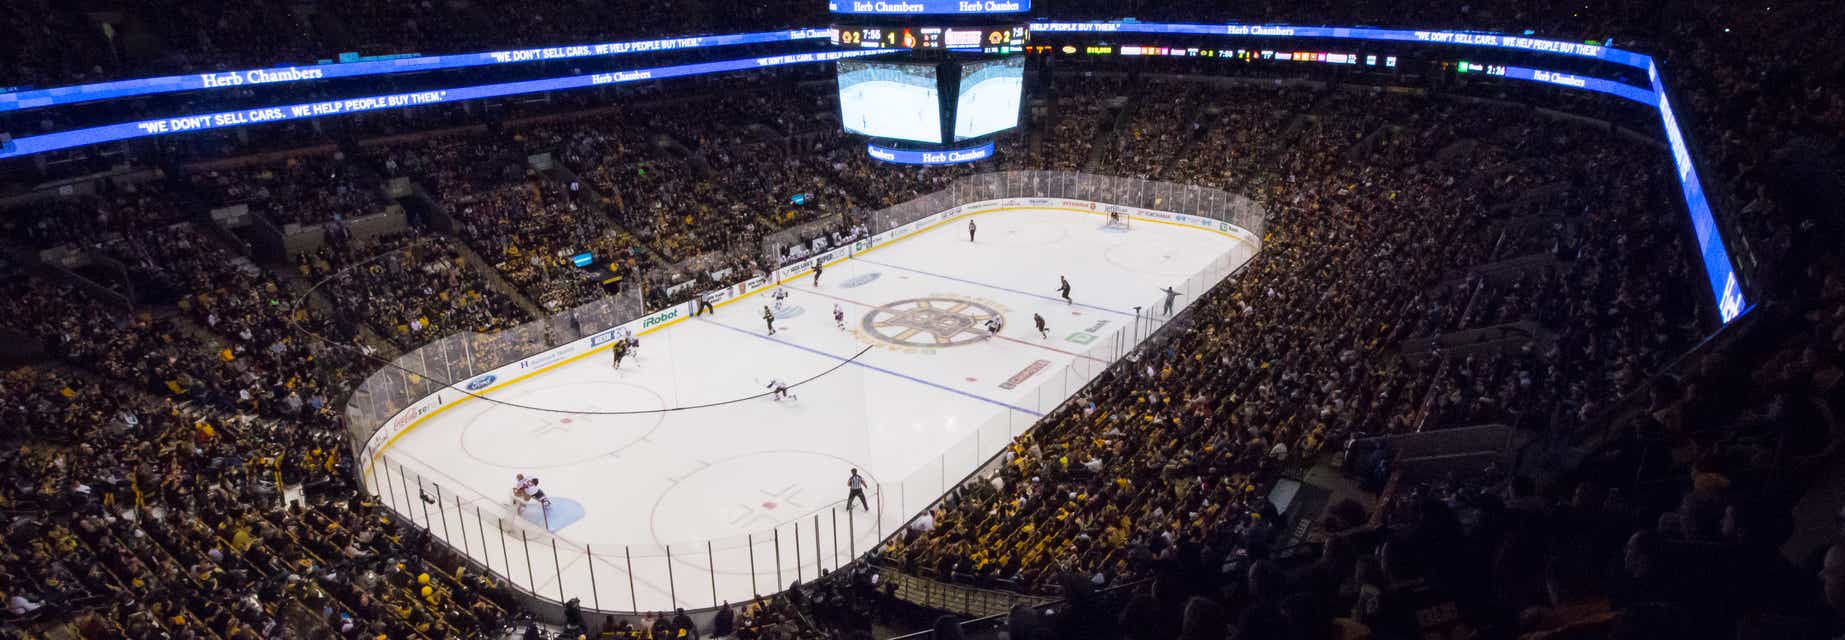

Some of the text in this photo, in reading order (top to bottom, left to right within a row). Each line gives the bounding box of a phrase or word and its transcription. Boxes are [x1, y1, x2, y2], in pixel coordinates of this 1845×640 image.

[854, 1, 924, 11] Herb Chambers
[960, 1, 982, 12] Herb
[1050, 23, 1077, 31] PEOPLE
[1079, 23, 1093, 31] BUY
[1227, 25, 1294, 36] Herb Chambers
[853, 31, 860, 43] 2
[888, 32, 895, 44] 1
[1003, 30, 1010, 42] 2
[544, 47, 565, 60] SELL
[567, 46, 592, 58] CARS.
[595, 45, 608, 55] WE
[610, 43, 630, 54] HELP
[632, 41, 660, 52] PEOPLE
[662, 39, 677, 50] BUY
[1455, 33, 1472, 44] SELL
[1475, 35, 1497, 46] CARS.
[1503, 37, 1515, 47] WE
[1516, 38, 1533, 48] HELP
[1533, 39, 1558, 51] PEOPLE
[1560, 42, 1575, 53] BUY
[203, 66, 322, 88] Herb Chambers
[592, 69, 651, 84] Herb Chambers
[1534, 70, 1585, 87] Herb Chambers
[171, 116, 210, 132] DON'T
[215, 111, 247, 127] SELL
[251, 106, 286, 122] CARS.
[293, 102, 311, 118] WE
[313, 100, 342, 115] HELP
[345, 94, 386, 111] PEOPLE
[388, 91, 409, 106] BUY
[923, 150, 985, 163] Herb Chambers
[642, 309, 678, 329] iRobot
[471, 377, 493, 390] Ford
